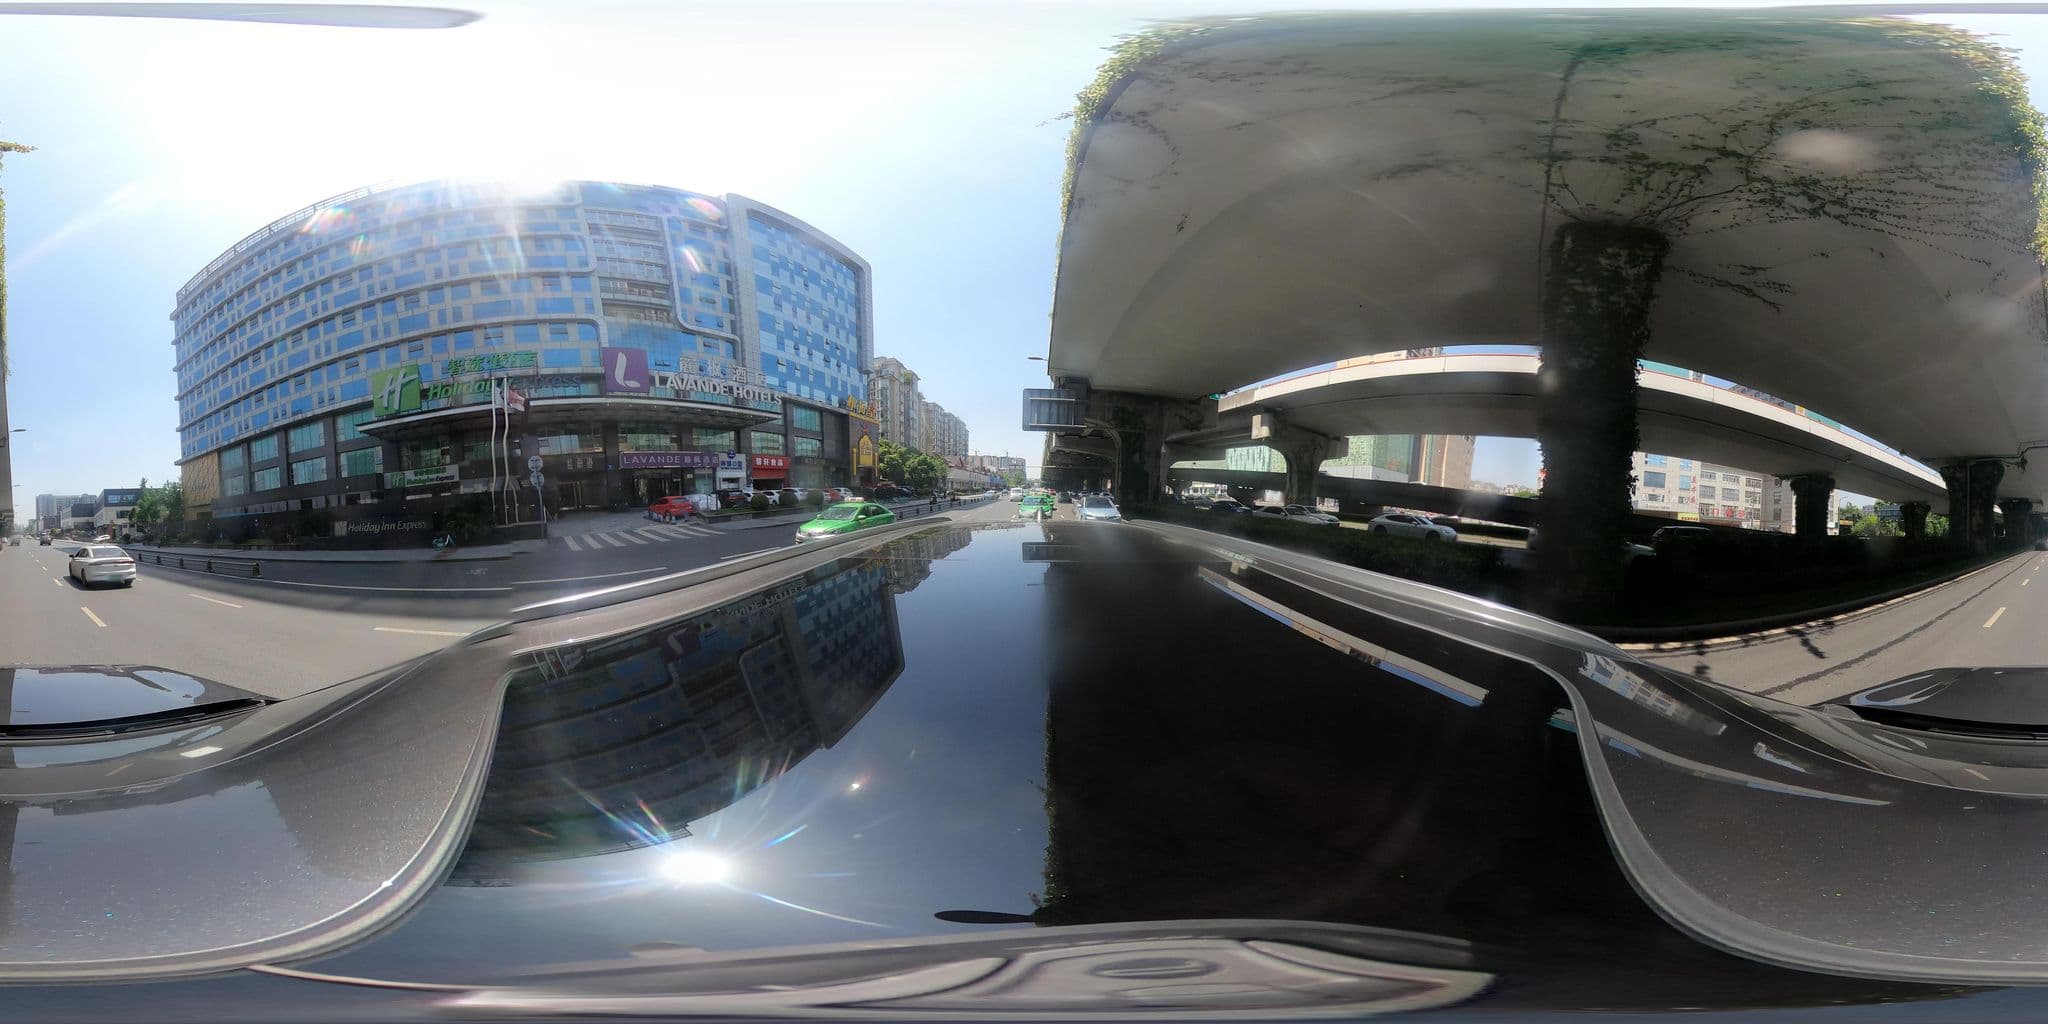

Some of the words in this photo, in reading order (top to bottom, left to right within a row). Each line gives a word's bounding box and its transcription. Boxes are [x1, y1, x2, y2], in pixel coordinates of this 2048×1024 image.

[653, 373, 729, 396] LAVANDE
[733, 384, 783, 406] HOTELS
[624, 455, 680, 464] LAVANDE
[348, 521, 380, 534] Holiday
[381, 521, 396, 531] Inn
[397, 520, 426, 532] Express
